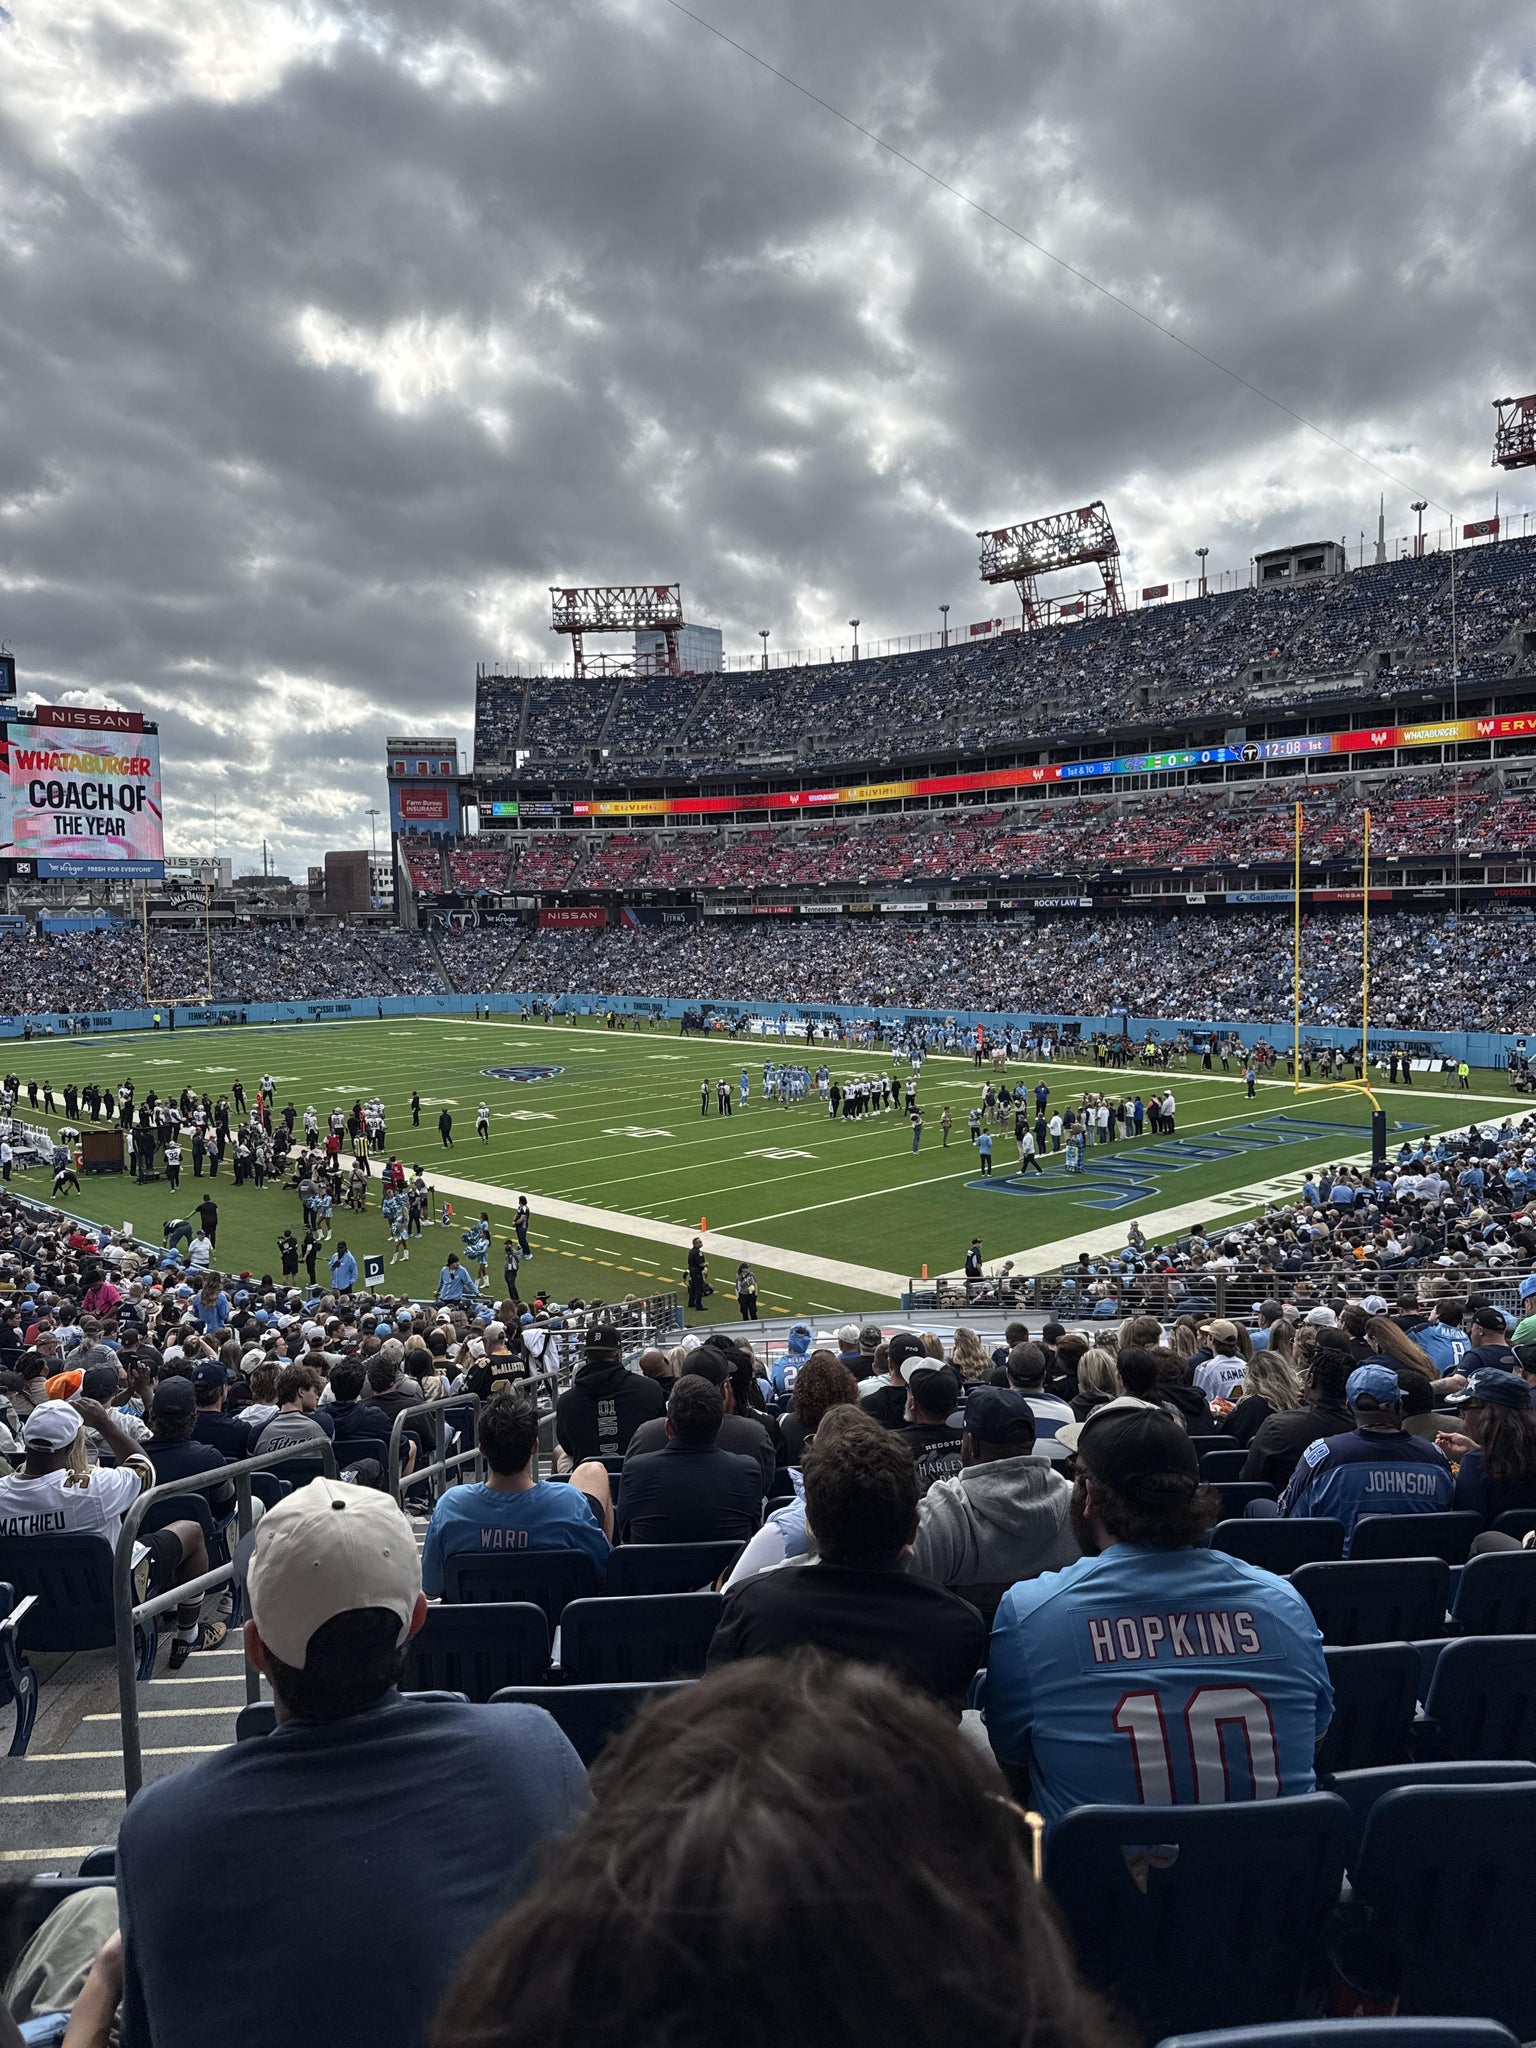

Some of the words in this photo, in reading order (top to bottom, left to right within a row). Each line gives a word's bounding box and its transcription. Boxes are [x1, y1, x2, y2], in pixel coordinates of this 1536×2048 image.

[52, 711, 130, 727] NISSAN
[1403, 727, 1459, 741] WHATABURGER
[1168, 755, 1177, 766] 0
[1201, 751, 1210, 763] 0
[1265, 741, 1301, 757] 12:08
[1309, 742, 1322, 750] 1st
[14, 749, 152, 776] WHATABURGER
[1067, 767, 1077, 776] 1st
[1078, 766, 1084, 774] &
[1086, 765, 1095, 773] 10
[1103, 765, 1111, 773] 20
[28, 779, 114, 810] COACH
[119, 784, 146, 812] OF
[53, 815, 82, 835] THE
[85, 817, 126, 836] YEAR
[60, 862, 84, 875] Kroger
[164, 858, 221, 867] NISSAN
[1250, 893, 1288, 902] Gallagher
[1493, 888, 1531, 897] verizon
[1034, 899, 1059, 907] ROCKY
[494, 913, 519, 926] Kroger
[547, 911, 598, 920] NISSAN
[169, 1152, 178, 1161] 32
[1210, 1191, 1272, 1207] US
[370, 1262, 379, 1275] D
[267, 1434, 313, 1453] Tita
[918, 1459, 963, 1479] HARLEY
[1364, 1470, 1437, 1496] JOHNSON
[0, 1510, 66, 1537] MATHIEU
[480, 1527, 529, 1549] WARD
[1087, 1610, 1261, 1663] HOPKINS
[1111, 1682, 1283, 1807] 10
